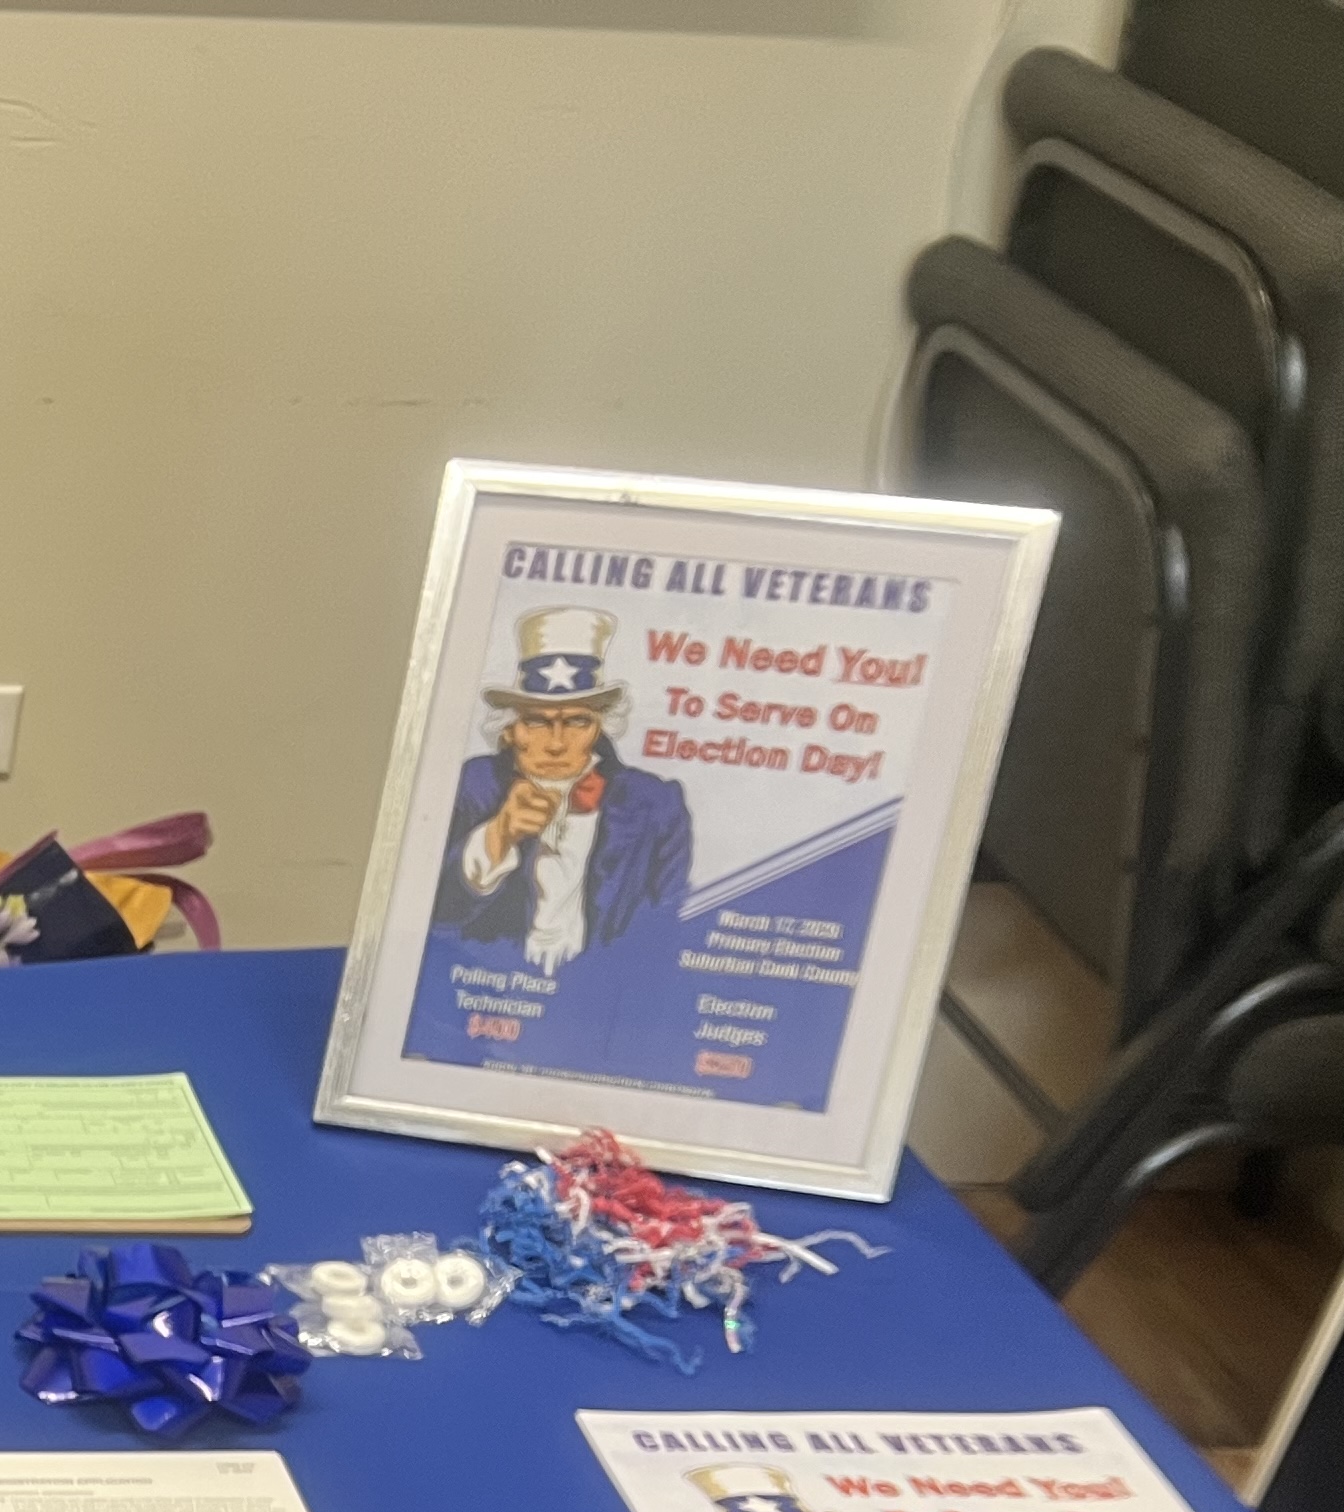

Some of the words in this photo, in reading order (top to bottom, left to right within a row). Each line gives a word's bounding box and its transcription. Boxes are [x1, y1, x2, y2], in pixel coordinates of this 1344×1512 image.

[501, 546, 657, 592] CALLING
[666, 558, 729, 598] ALL
[739, 564, 935, 614] VETERANS
[646, 627, 709, 668] We
[718, 634, 829, 679] Need
[832, 642, 930, 687] You!
[664, 685, 708, 720] To
[714, 689, 819, 733] Serve
[826, 701, 882, 736] On
[641, 727, 791, 773] Election
[800, 743, 889, 784] Day!
[631, 1428, 798, 1454] CALLING
[803, 1430, 876, 1455] ALL
[877, 1431, 1088, 1456] VETERANS
[822, 1472, 903, 1499] We
[905, 1473, 1026, 1500] Need
